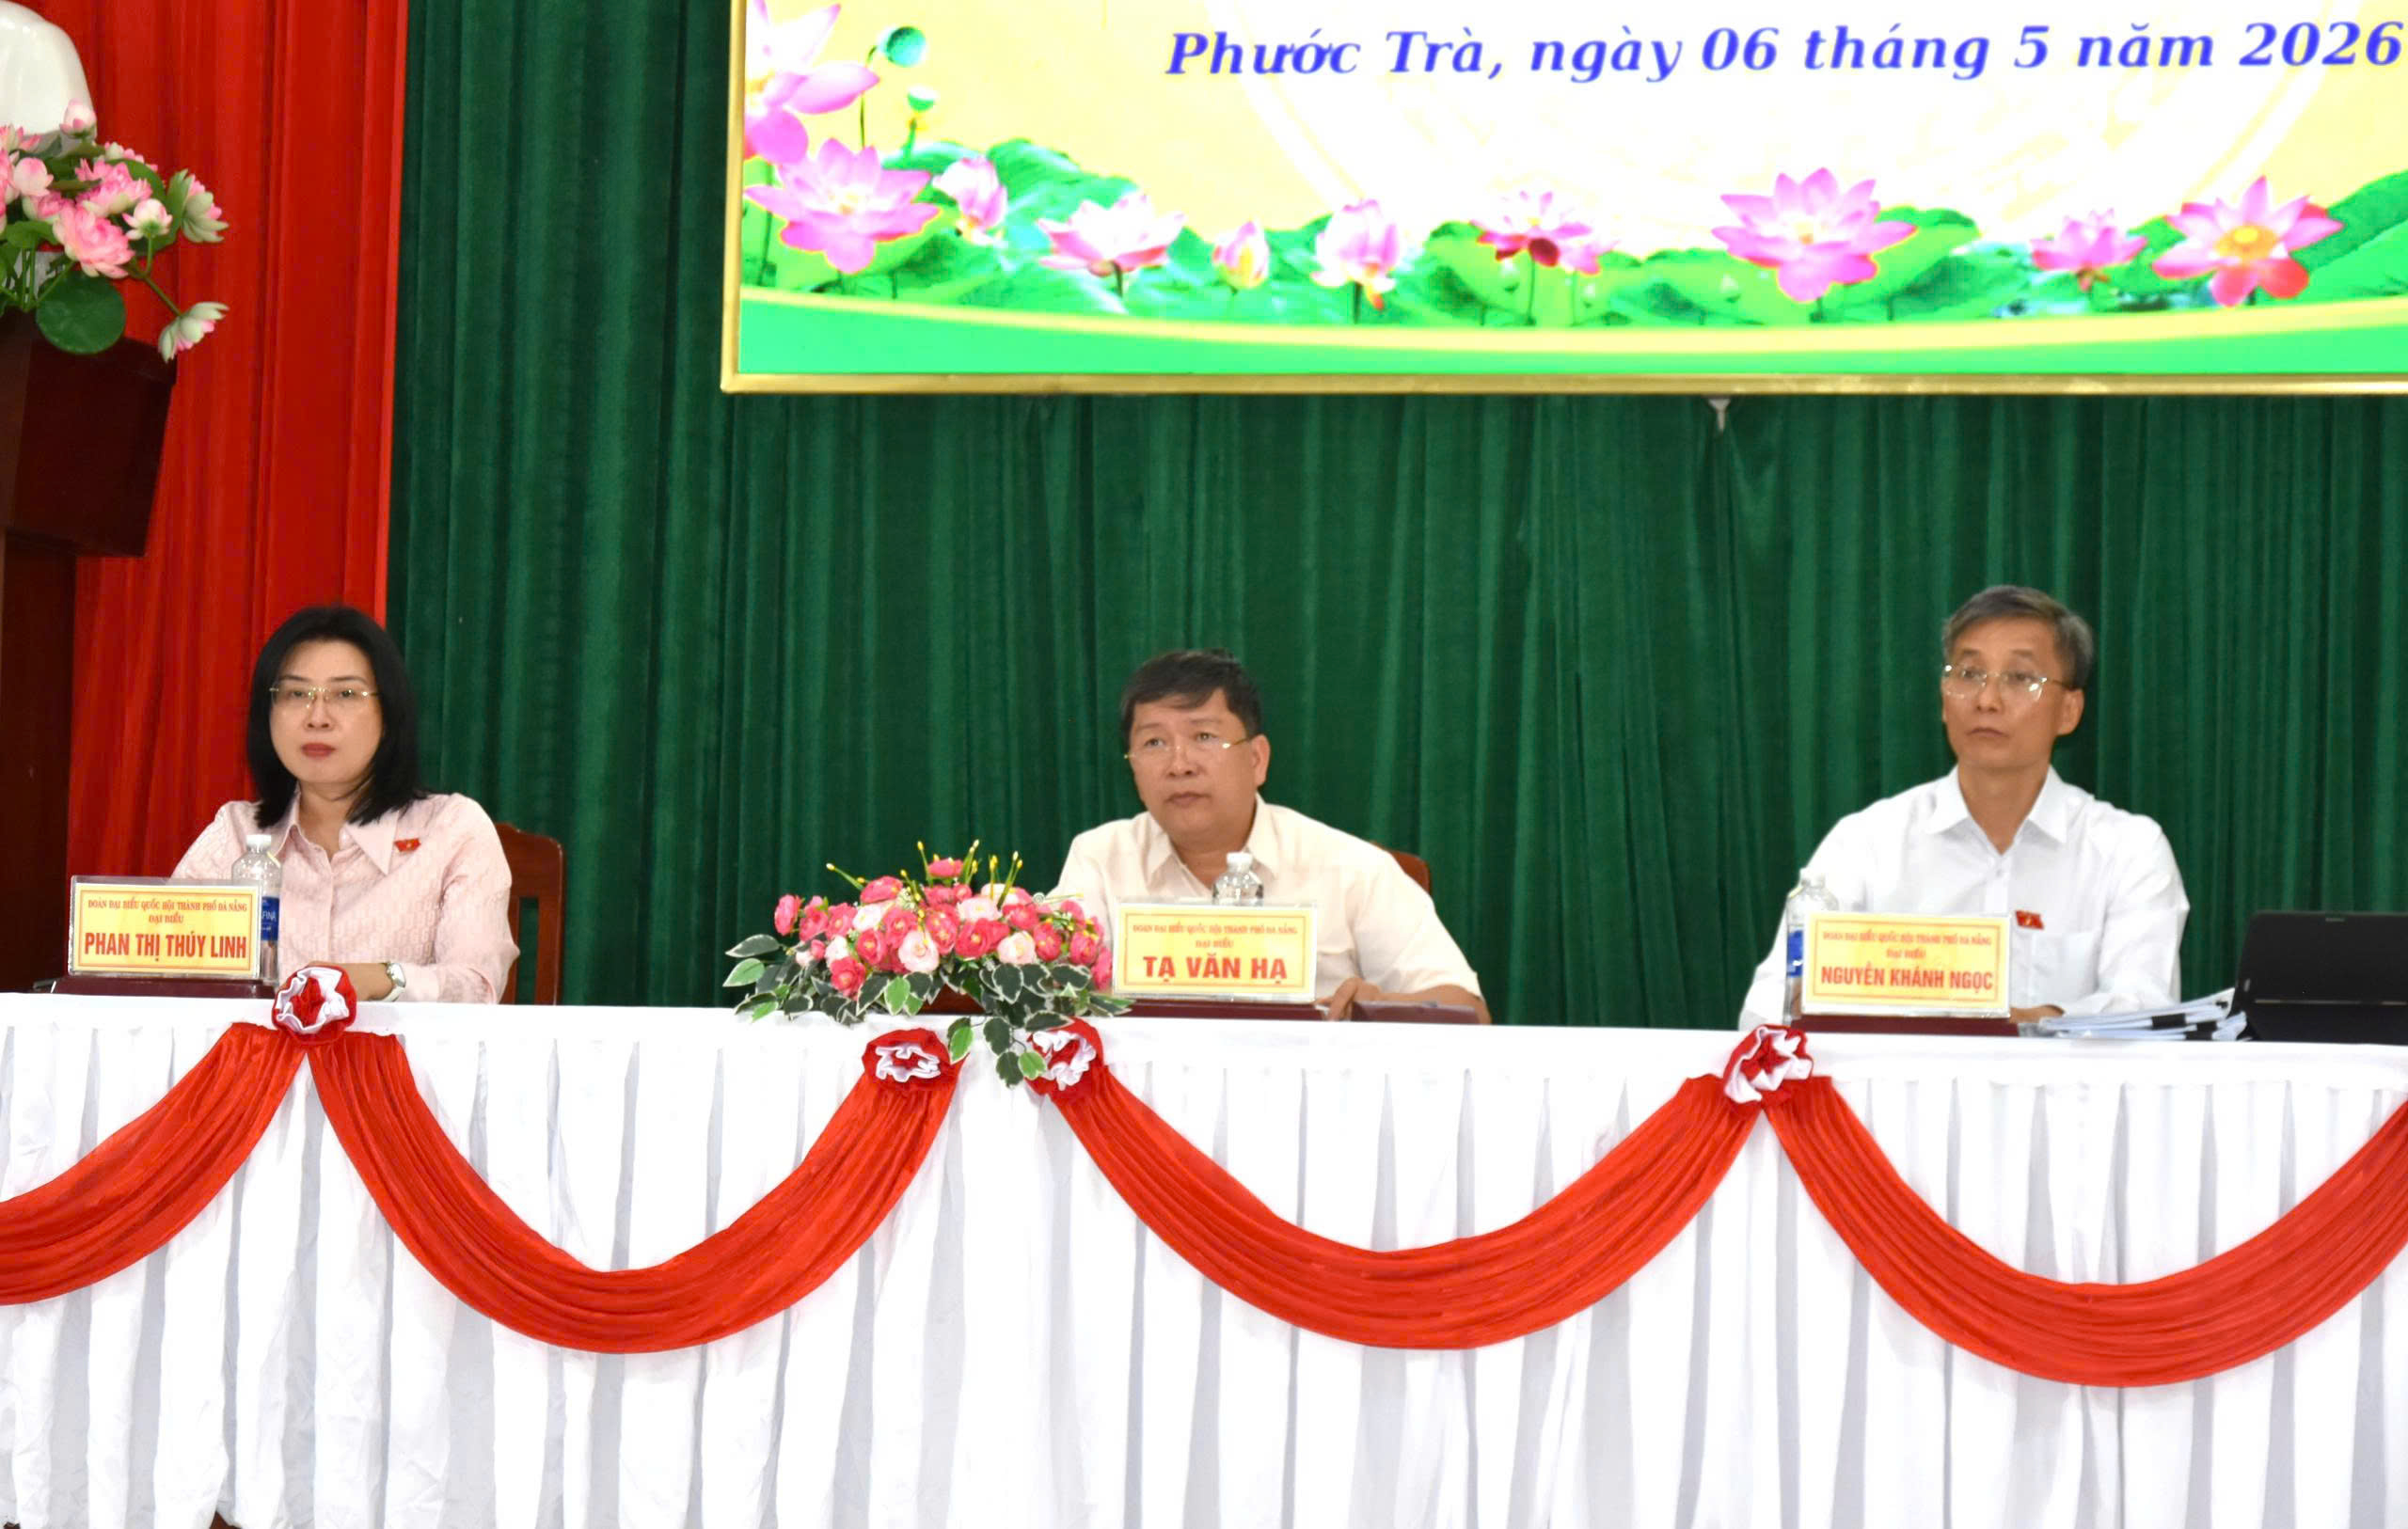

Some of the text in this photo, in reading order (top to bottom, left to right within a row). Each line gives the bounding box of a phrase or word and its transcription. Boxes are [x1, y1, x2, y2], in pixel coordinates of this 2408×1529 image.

[1164, 21, 2405, 83] Phước Trà, ngày 06 tháng 5 năm 2026
[85, 930, 246, 961] PHAN THỊ THÚY LINH
[1143, 953, 1287, 985] TẠ VĂN HẠ
[1891, 967, 1944, 987] KHÁNH
[1950, 970, 1993, 993] NGỌC
